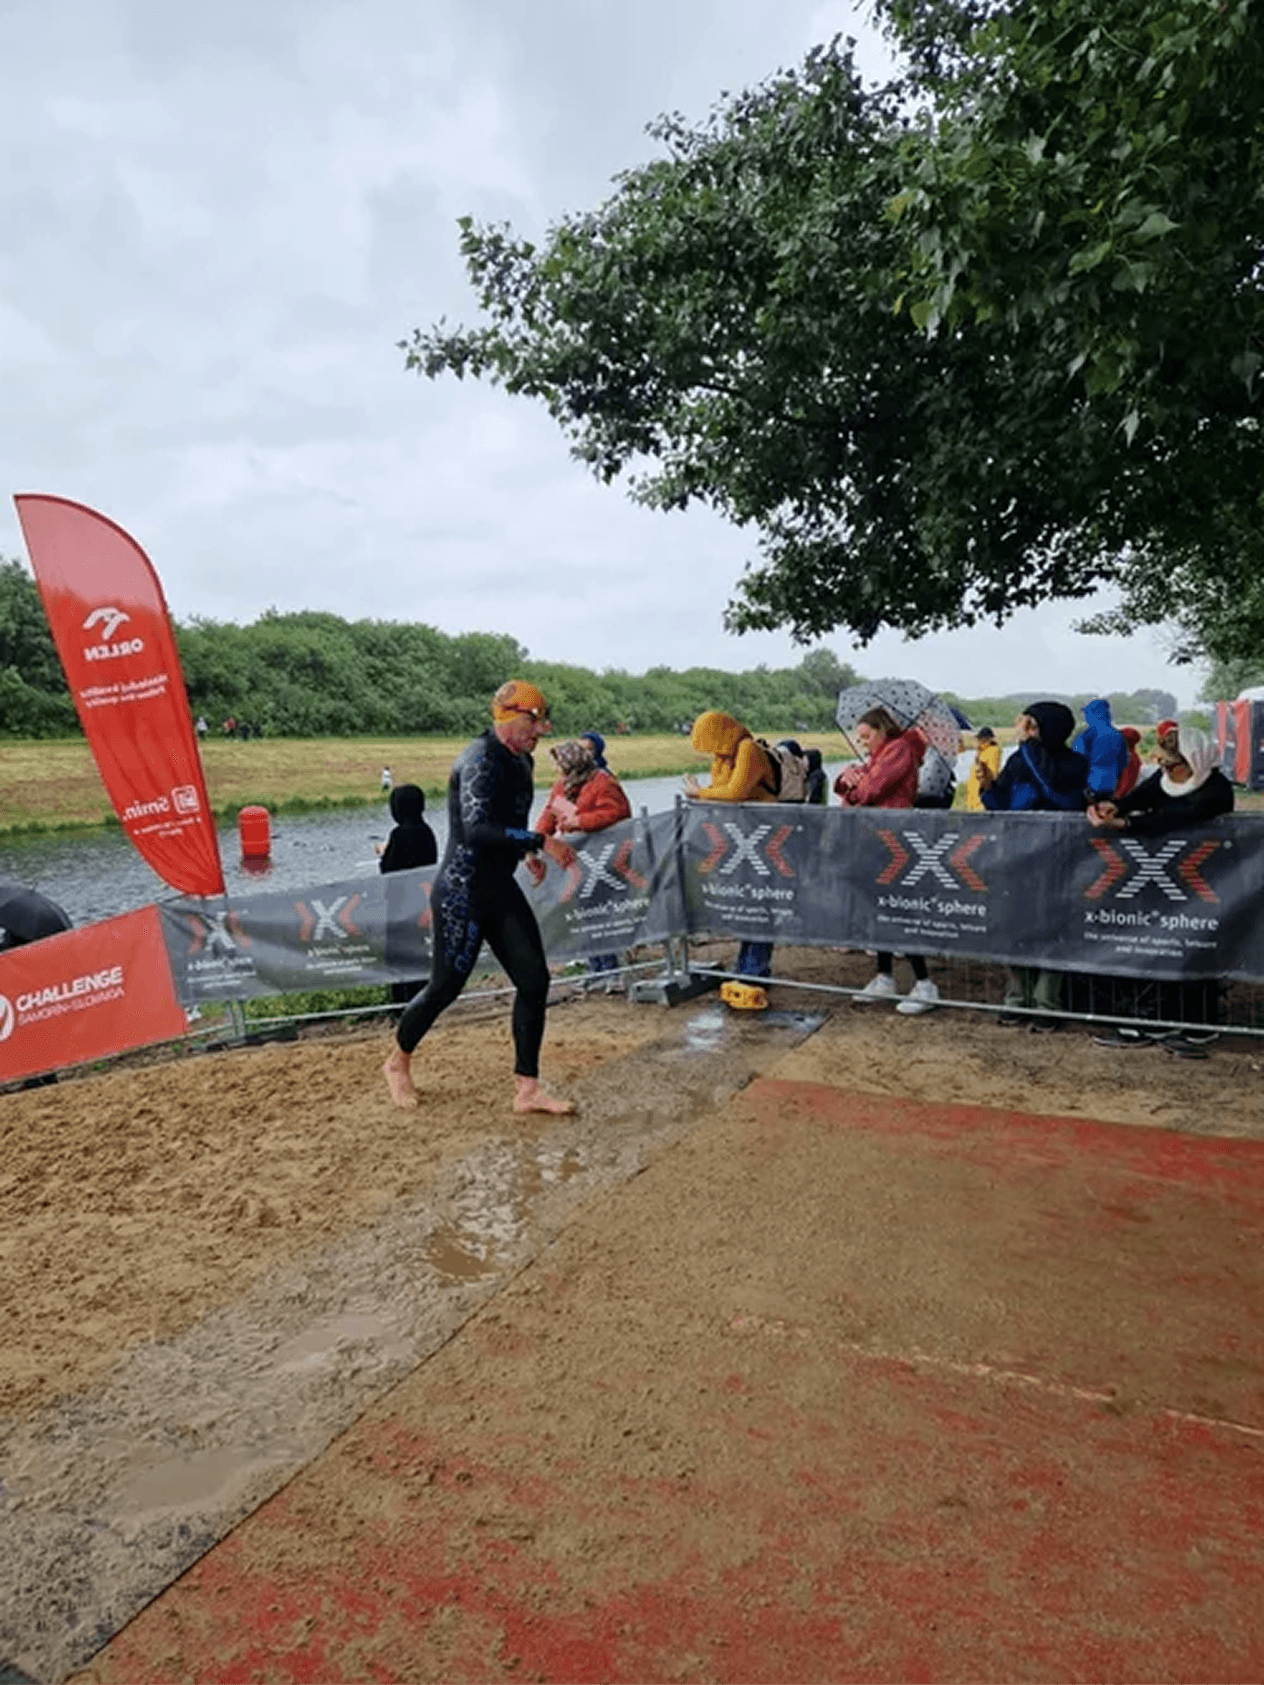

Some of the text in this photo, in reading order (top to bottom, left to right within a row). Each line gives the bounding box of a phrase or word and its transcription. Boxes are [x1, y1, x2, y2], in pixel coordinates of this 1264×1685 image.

[937, 899, 987, 917] sphere
[1160, 913, 1219, 931] sphere
[16, 966, 124, 1012] CHALLENGE
